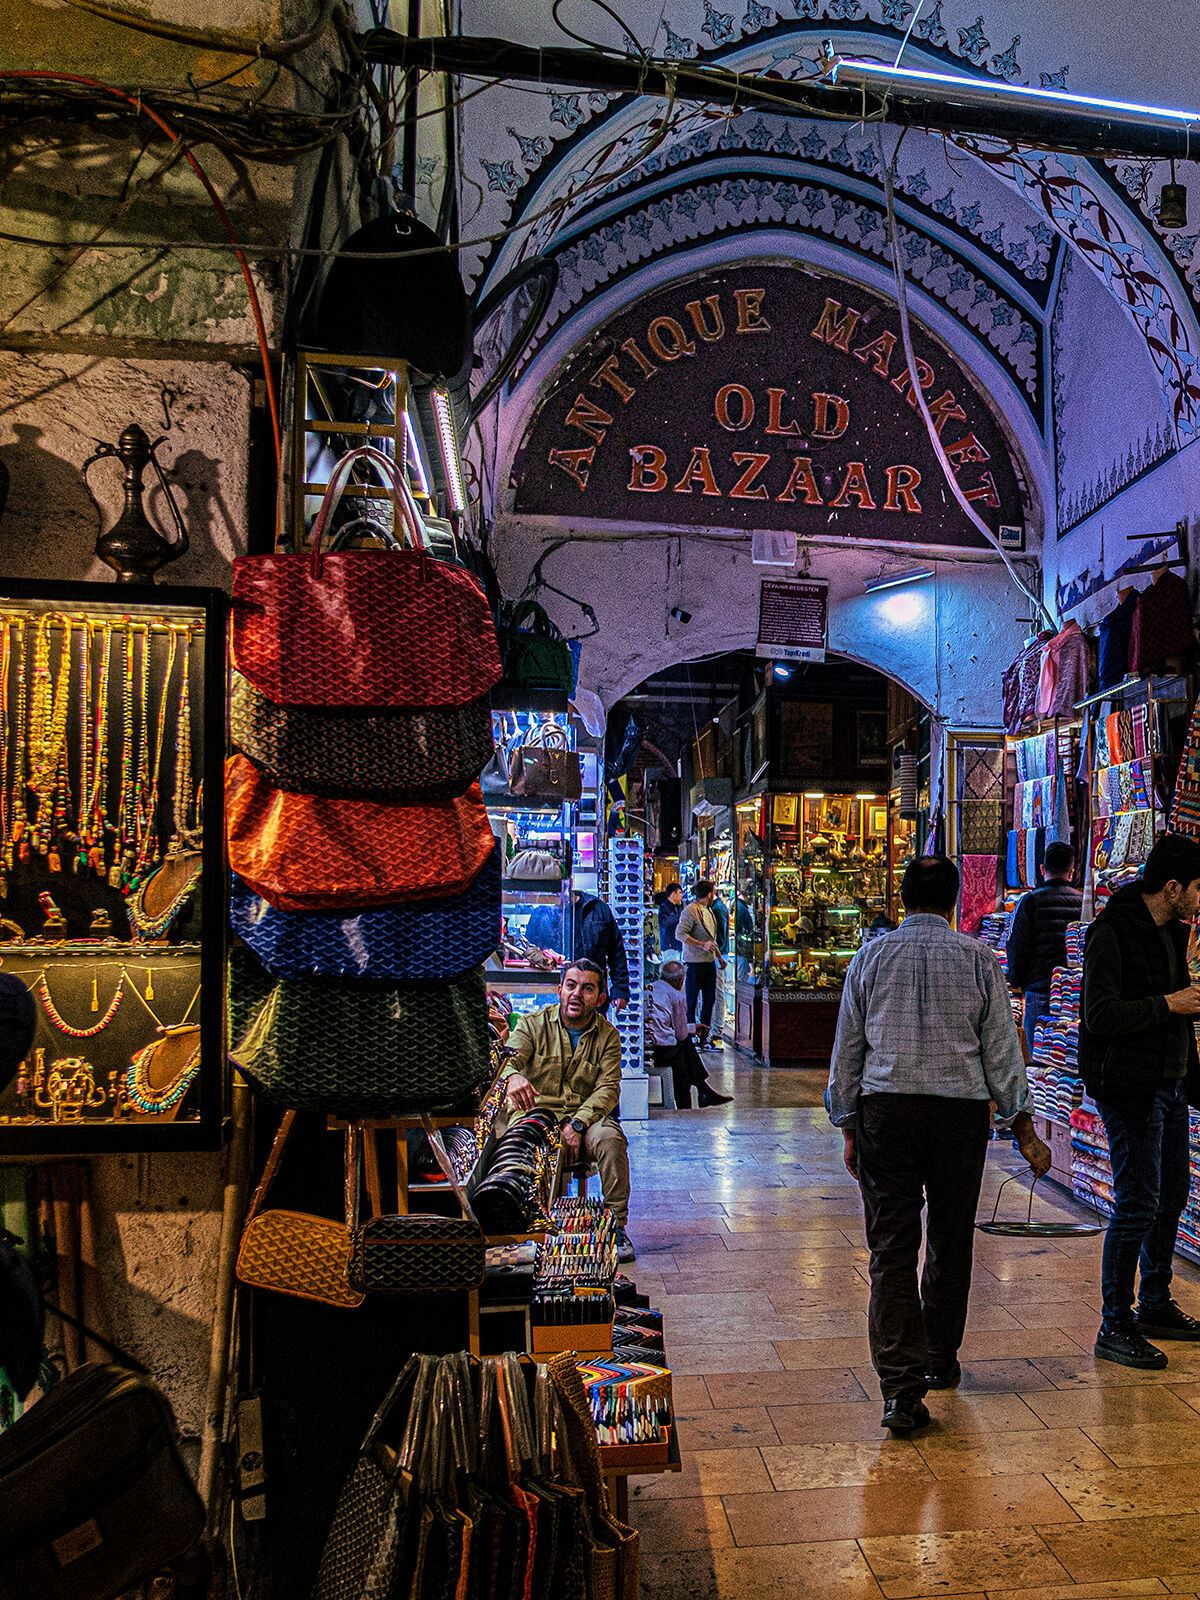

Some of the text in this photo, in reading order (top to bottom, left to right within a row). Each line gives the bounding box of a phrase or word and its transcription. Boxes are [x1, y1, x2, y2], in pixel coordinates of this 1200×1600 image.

[549, 288, 1002, 509] ANTIQUE MARKET
[715, 383, 850, 440] OLD
[627, 446, 922, 515] BAZAAR
